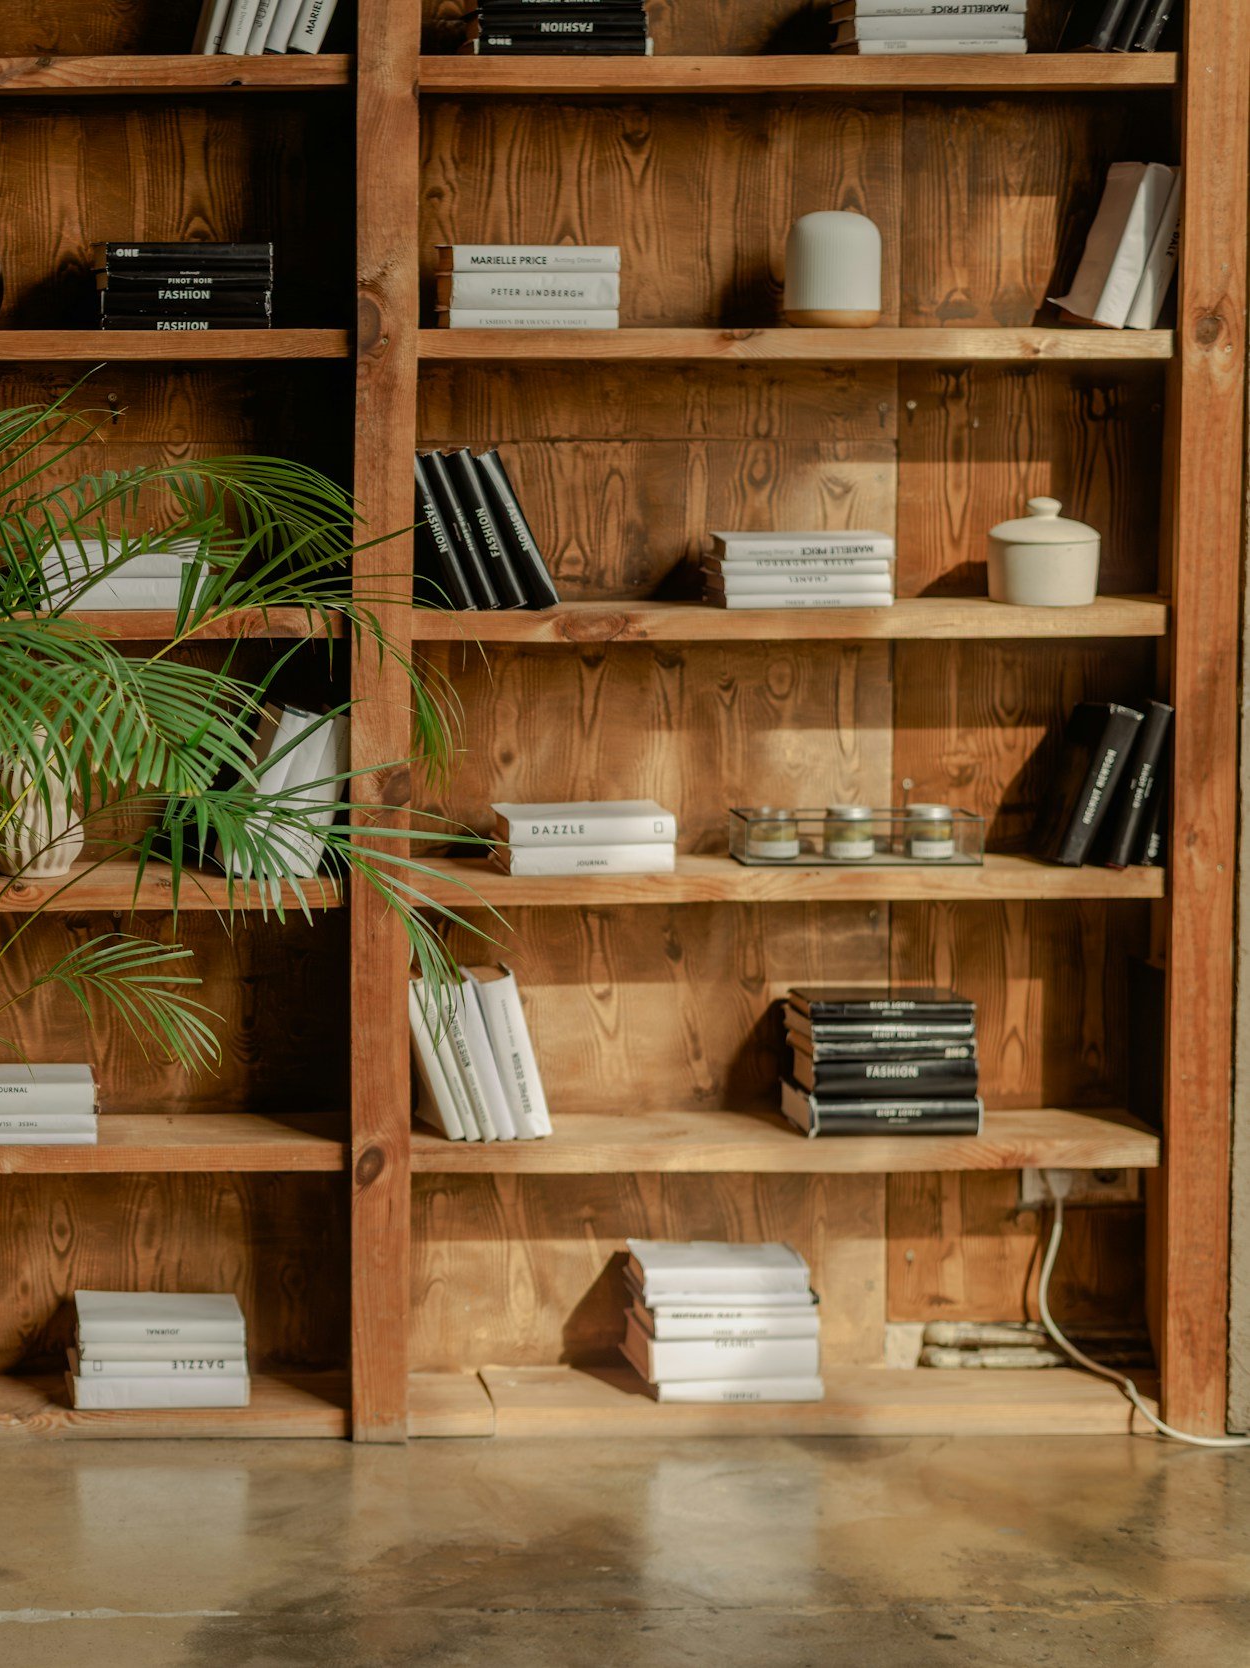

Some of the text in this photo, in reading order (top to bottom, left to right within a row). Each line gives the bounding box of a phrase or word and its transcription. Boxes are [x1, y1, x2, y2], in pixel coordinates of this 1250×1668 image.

[930, 5, 959, 14] PRICE
[961, 4, 1010, 13] MARIELLE
[540, 22, 594, 33] FASHION
[487, 38, 513, 46] ONE
[115, 248, 140, 257] ONE
[470, 256, 517, 265] MARIELLE
[519, 256, 547, 265] PRICE
[167, 277, 214, 285] PINOT NOIR
[157, 290, 211, 300] FASHION
[490, 288, 585, 298] PETER LINDBERGH
[156, 321, 209, 331] FASHION
[423, 502, 449, 554] FASHION
[505, 501, 531, 551] FASHION
[475, 507, 501, 558] FASHION
[801, 547, 828, 556] PRICE
[829, 545, 874, 555] MARIELLE
[1096, 748, 1118, 789] NEWTON
[531, 824, 586, 835] DAZZLE
[456, 1039, 472, 1068] DESIGN
[511, 1051, 525, 1080] DESIGN
[865, 1065, 920, 1079] FASHION
[516, 1081, 533, 1114] GRAPHIC
[145, 1328, 181, 1336] JOURNAL
[171, 1360, 226, 1370] DAZZLE
